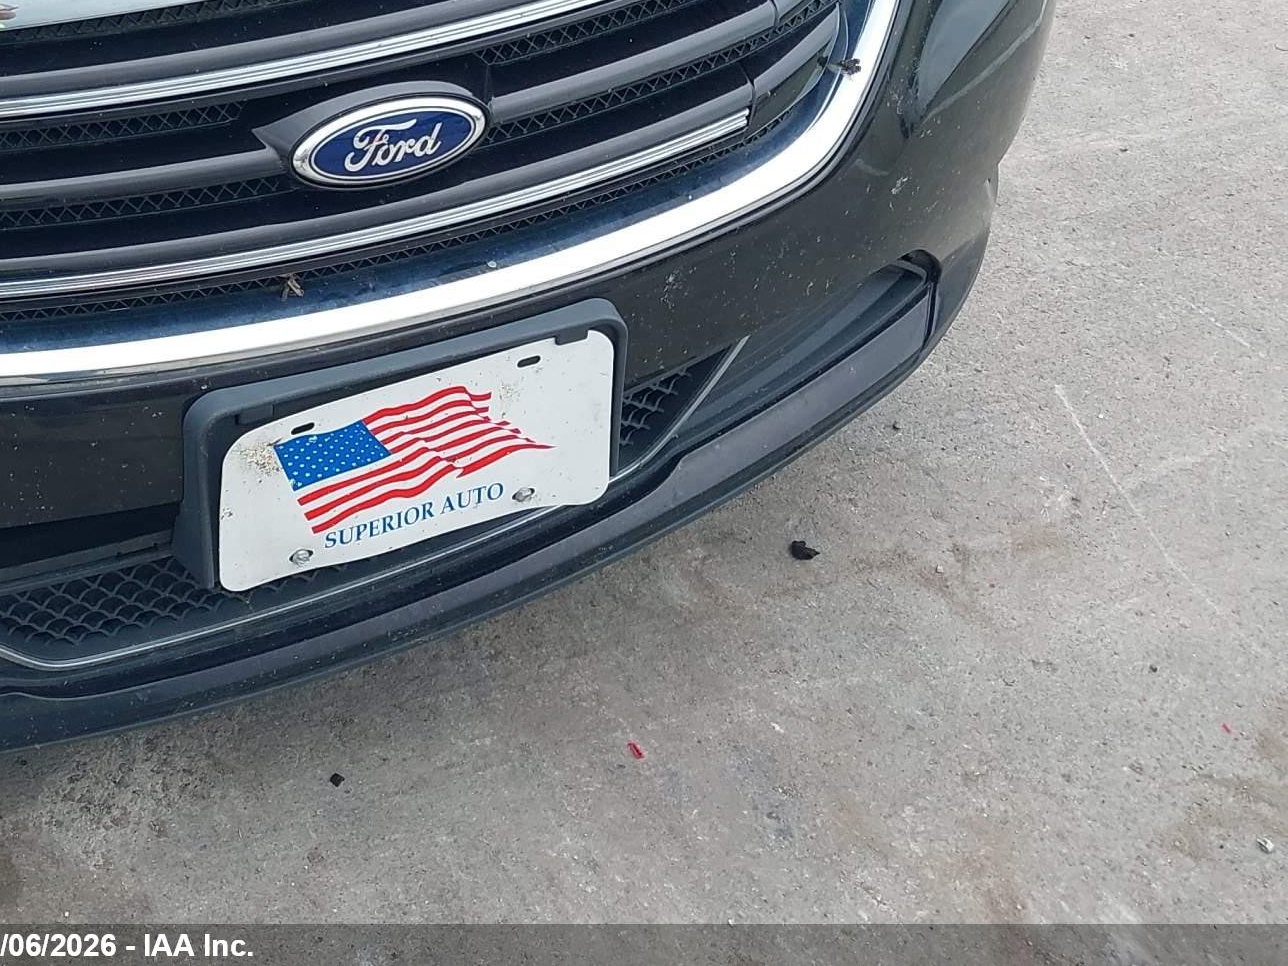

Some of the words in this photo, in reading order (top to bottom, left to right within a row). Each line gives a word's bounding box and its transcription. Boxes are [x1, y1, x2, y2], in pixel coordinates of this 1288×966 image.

[344, 118, 444, 172] Ford
[324, 501, 435, 549] SUPERIOR
[440, 482, 504, 515] AUTO
